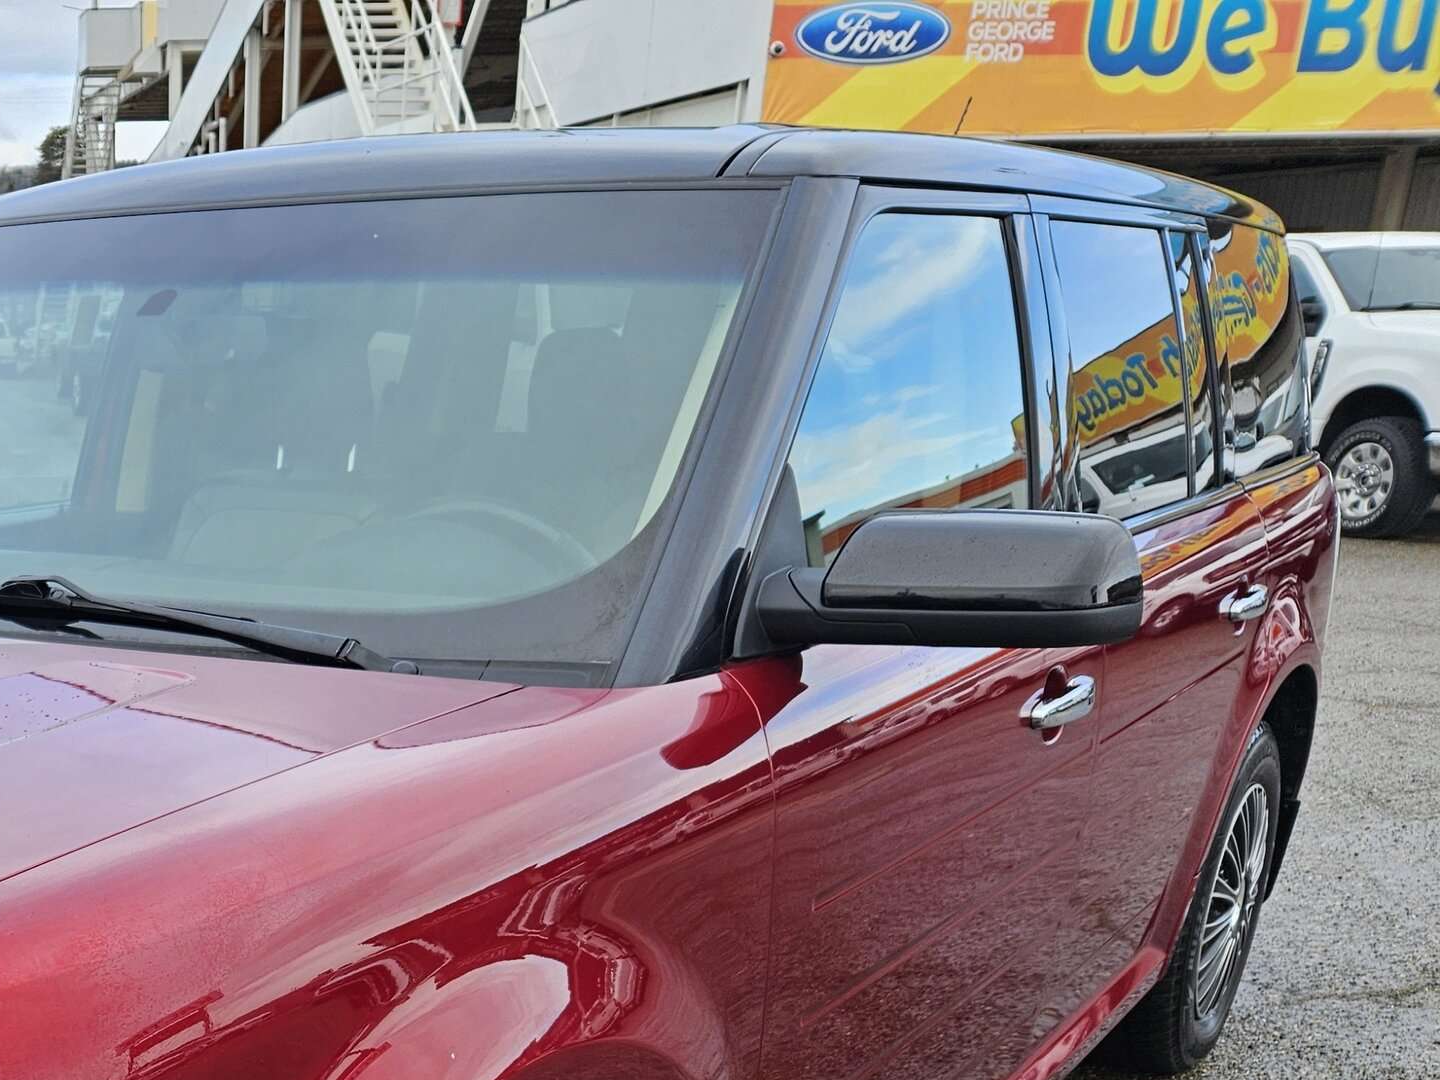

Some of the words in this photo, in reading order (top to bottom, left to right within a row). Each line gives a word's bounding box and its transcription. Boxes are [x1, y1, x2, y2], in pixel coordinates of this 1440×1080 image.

[971, 0, 1051, 19] PRINCE
[824, 8, 923, 54] Ford
[967, 21, 1057, 42] GEORGE
[963, 43, 1025, 63] FORD
[1088, 0, 1267, 77] We
[1296, 0, 1440, 97] Bu
